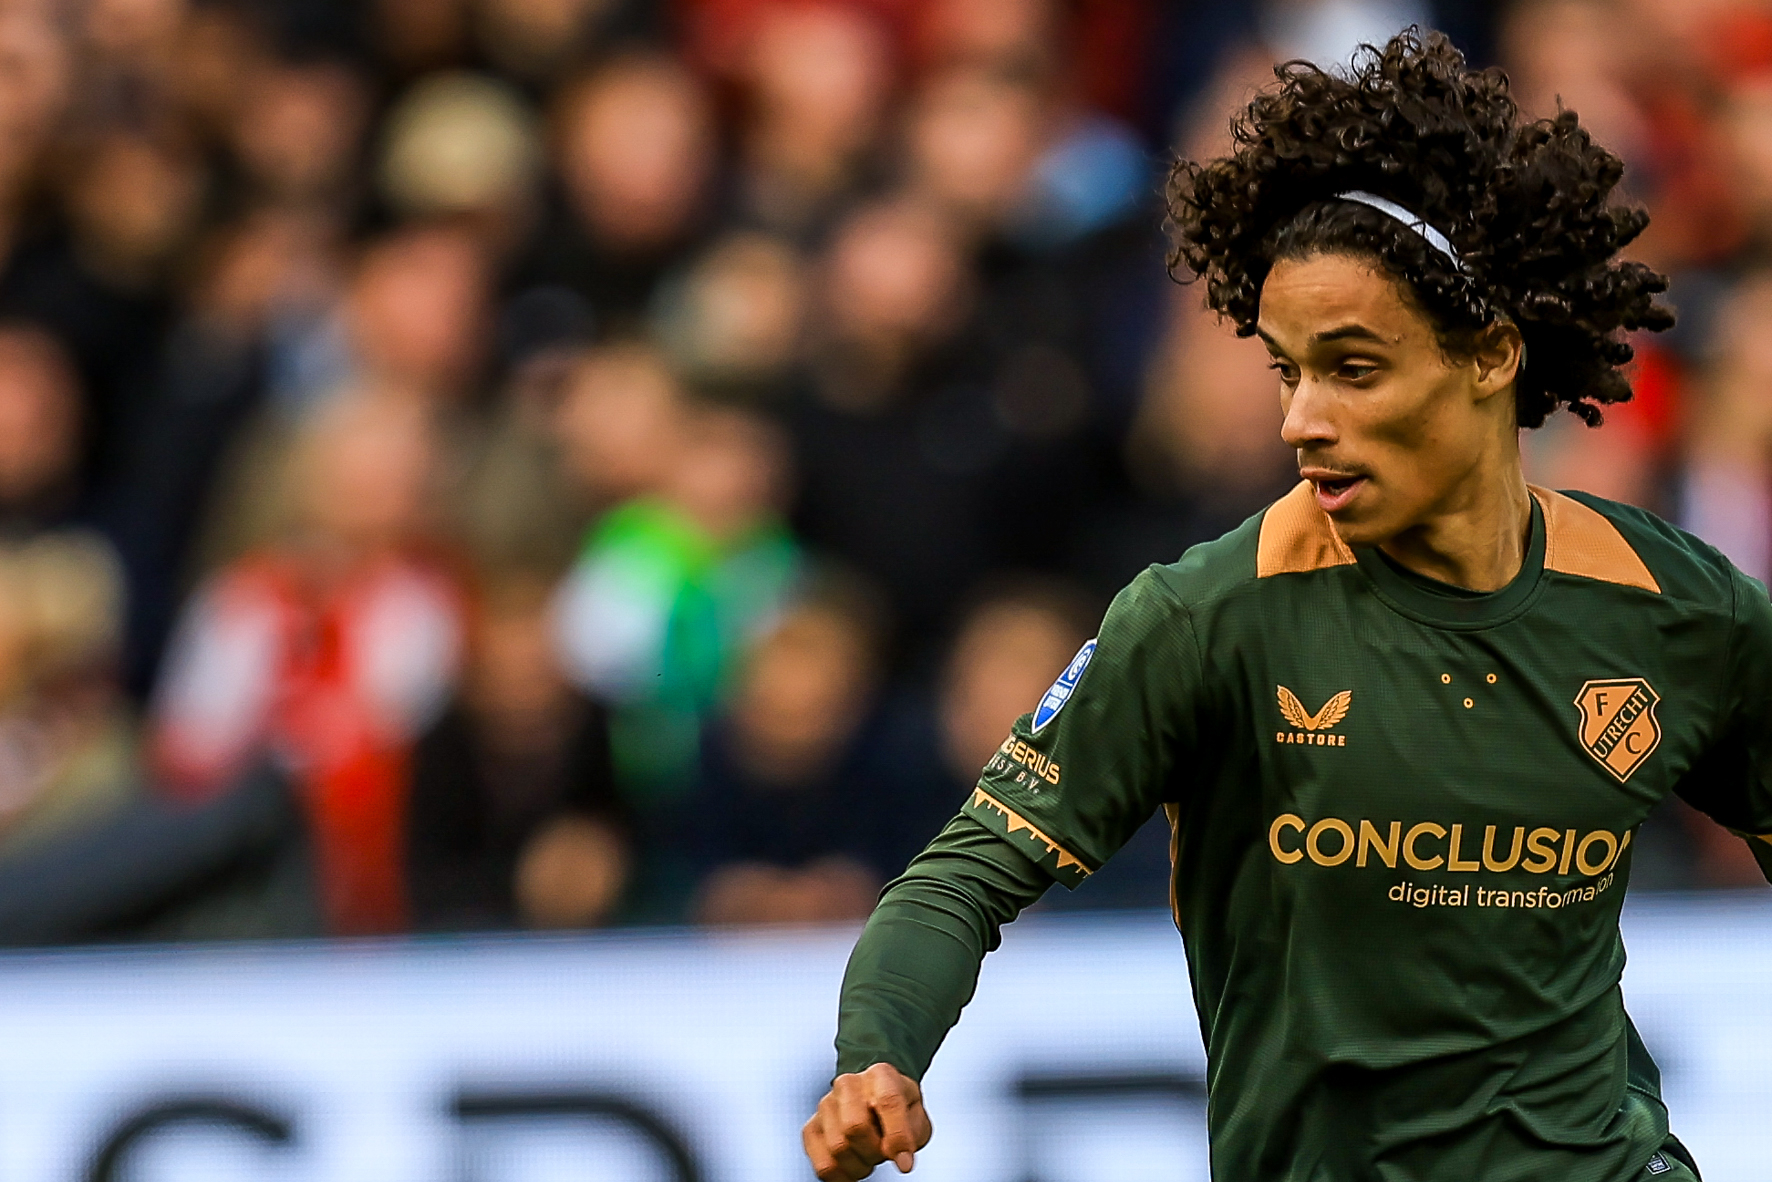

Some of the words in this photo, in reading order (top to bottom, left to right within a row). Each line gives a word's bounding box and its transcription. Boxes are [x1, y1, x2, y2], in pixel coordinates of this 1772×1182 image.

[1595, 692, 1609, 716] F
[1593, 688, 1648, 758] UTRECHT
[1276, 731, 1346, 747] CASTORE
[1624, 731, 1642, 755] C
[1000, 734, 1060, 785] GERIUS
[1388, 881, 1470, 909] digital
